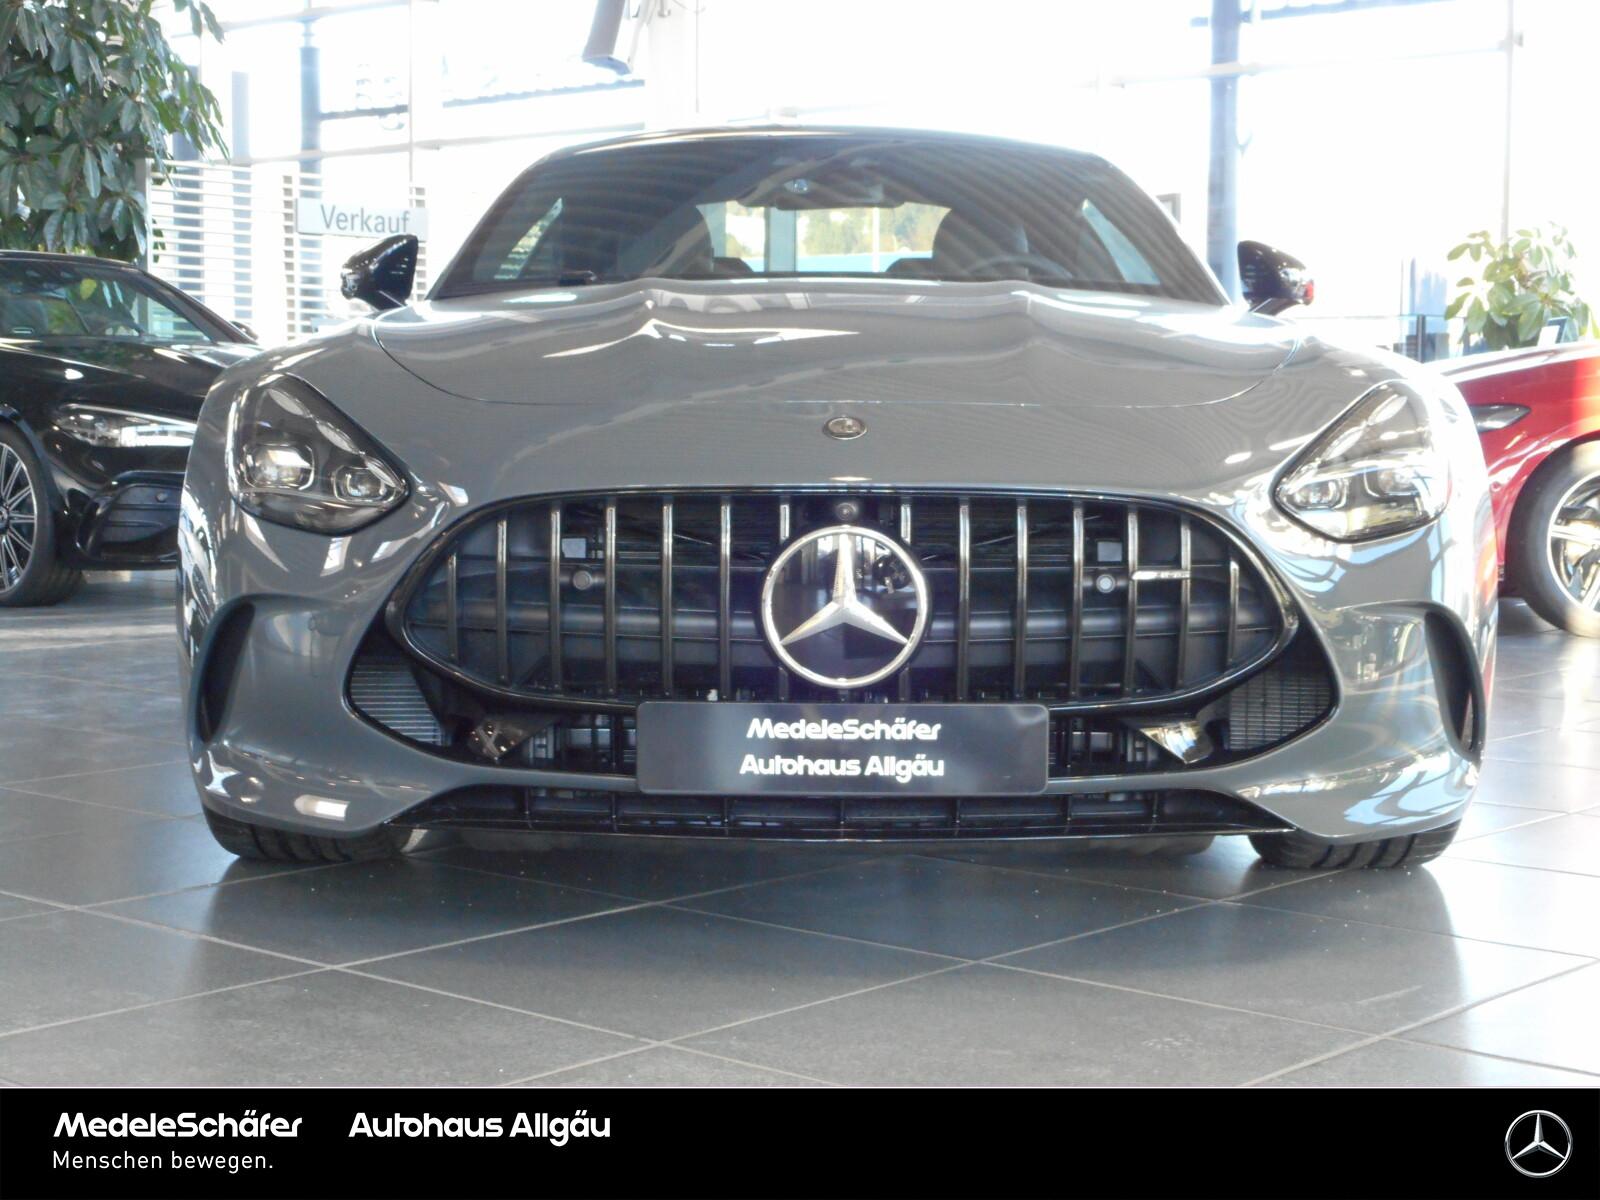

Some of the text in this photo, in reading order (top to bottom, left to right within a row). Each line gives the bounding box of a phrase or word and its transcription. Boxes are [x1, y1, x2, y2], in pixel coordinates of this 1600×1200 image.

[320, 203, 411, 233] Verkauf
[746, 717, 942, 740] MedeleSchäfer
[739, 753, 945, 783] Autohaus Allgäu
